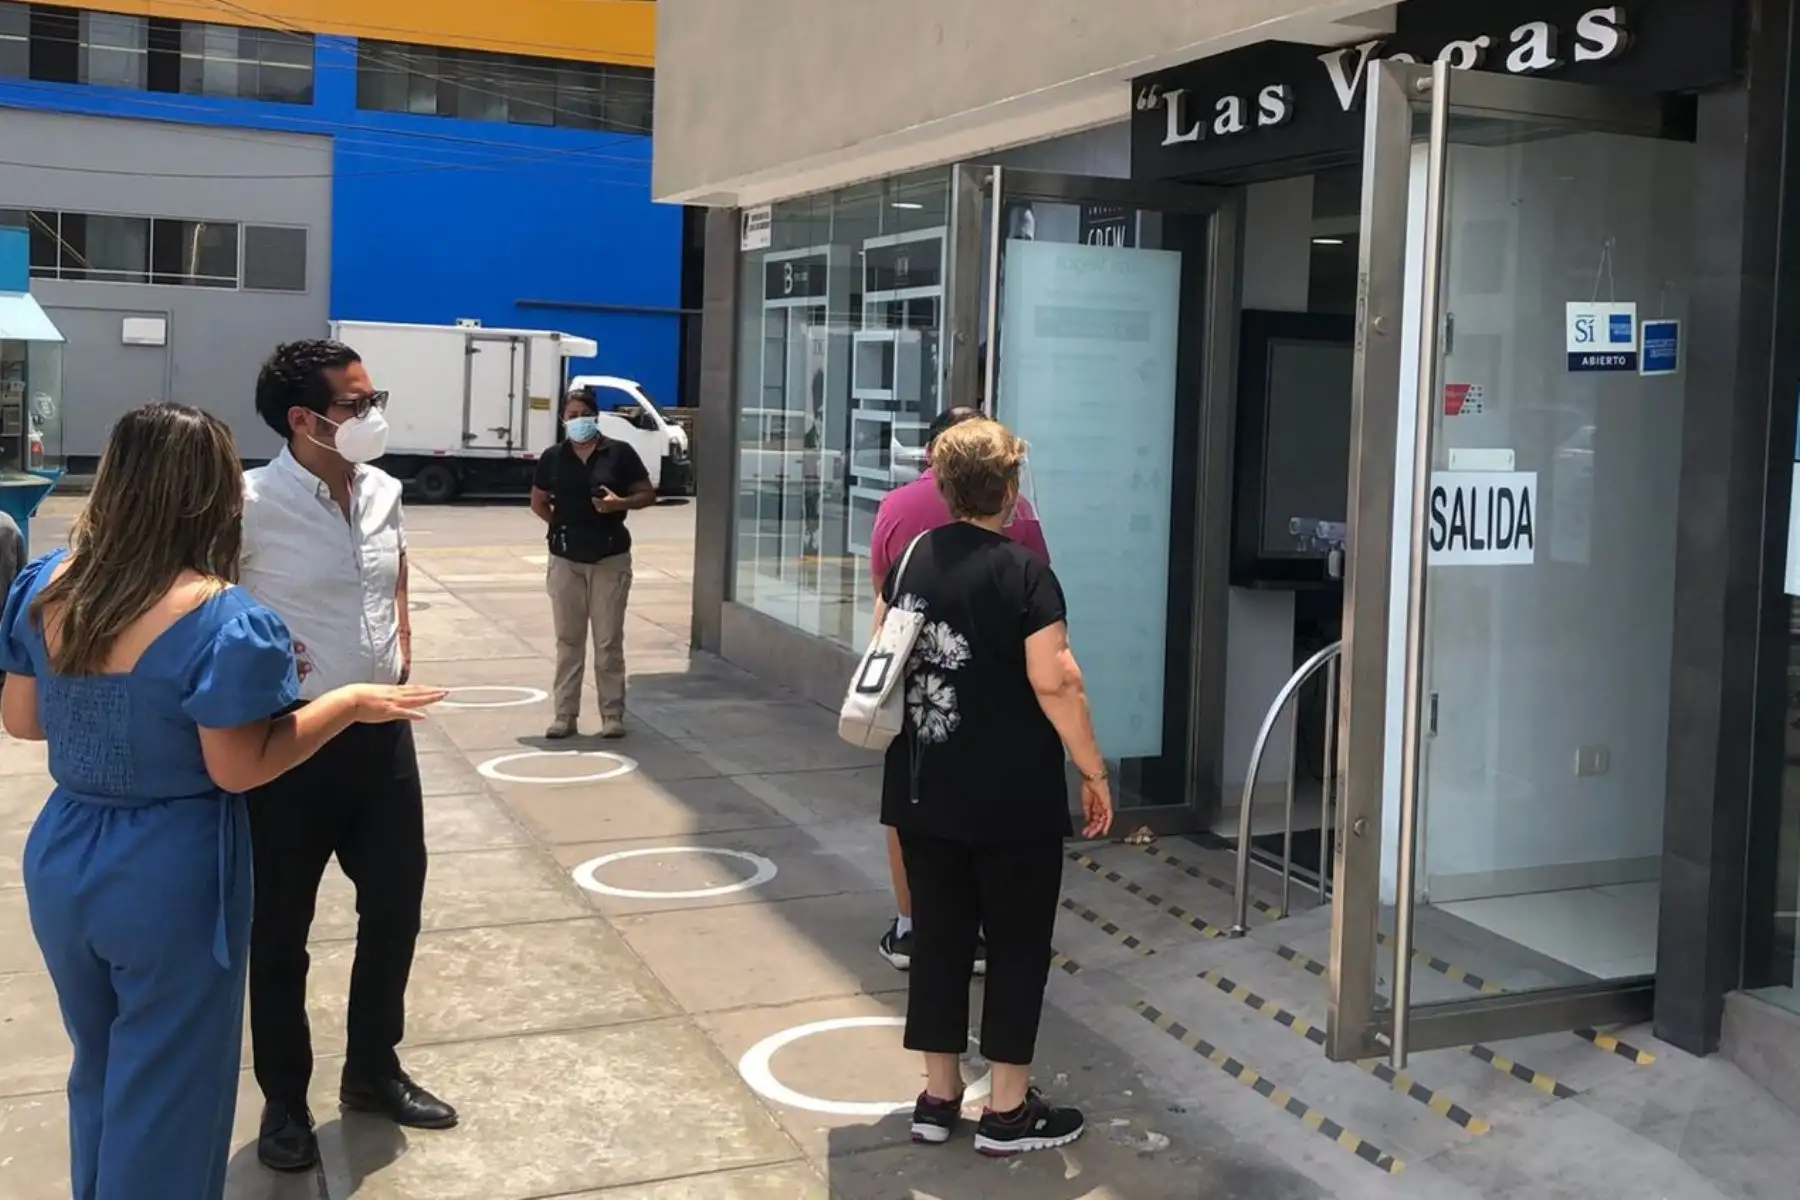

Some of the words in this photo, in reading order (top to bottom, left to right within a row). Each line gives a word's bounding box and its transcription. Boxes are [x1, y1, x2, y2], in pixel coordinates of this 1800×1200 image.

[1316, 6, 1619, 111] Vgas
[1575, 318, 1596, 343] Sí
[1581, 355, 1626, 366] ABIERTO
[1429, 485, 1534, 552] SALIDA
